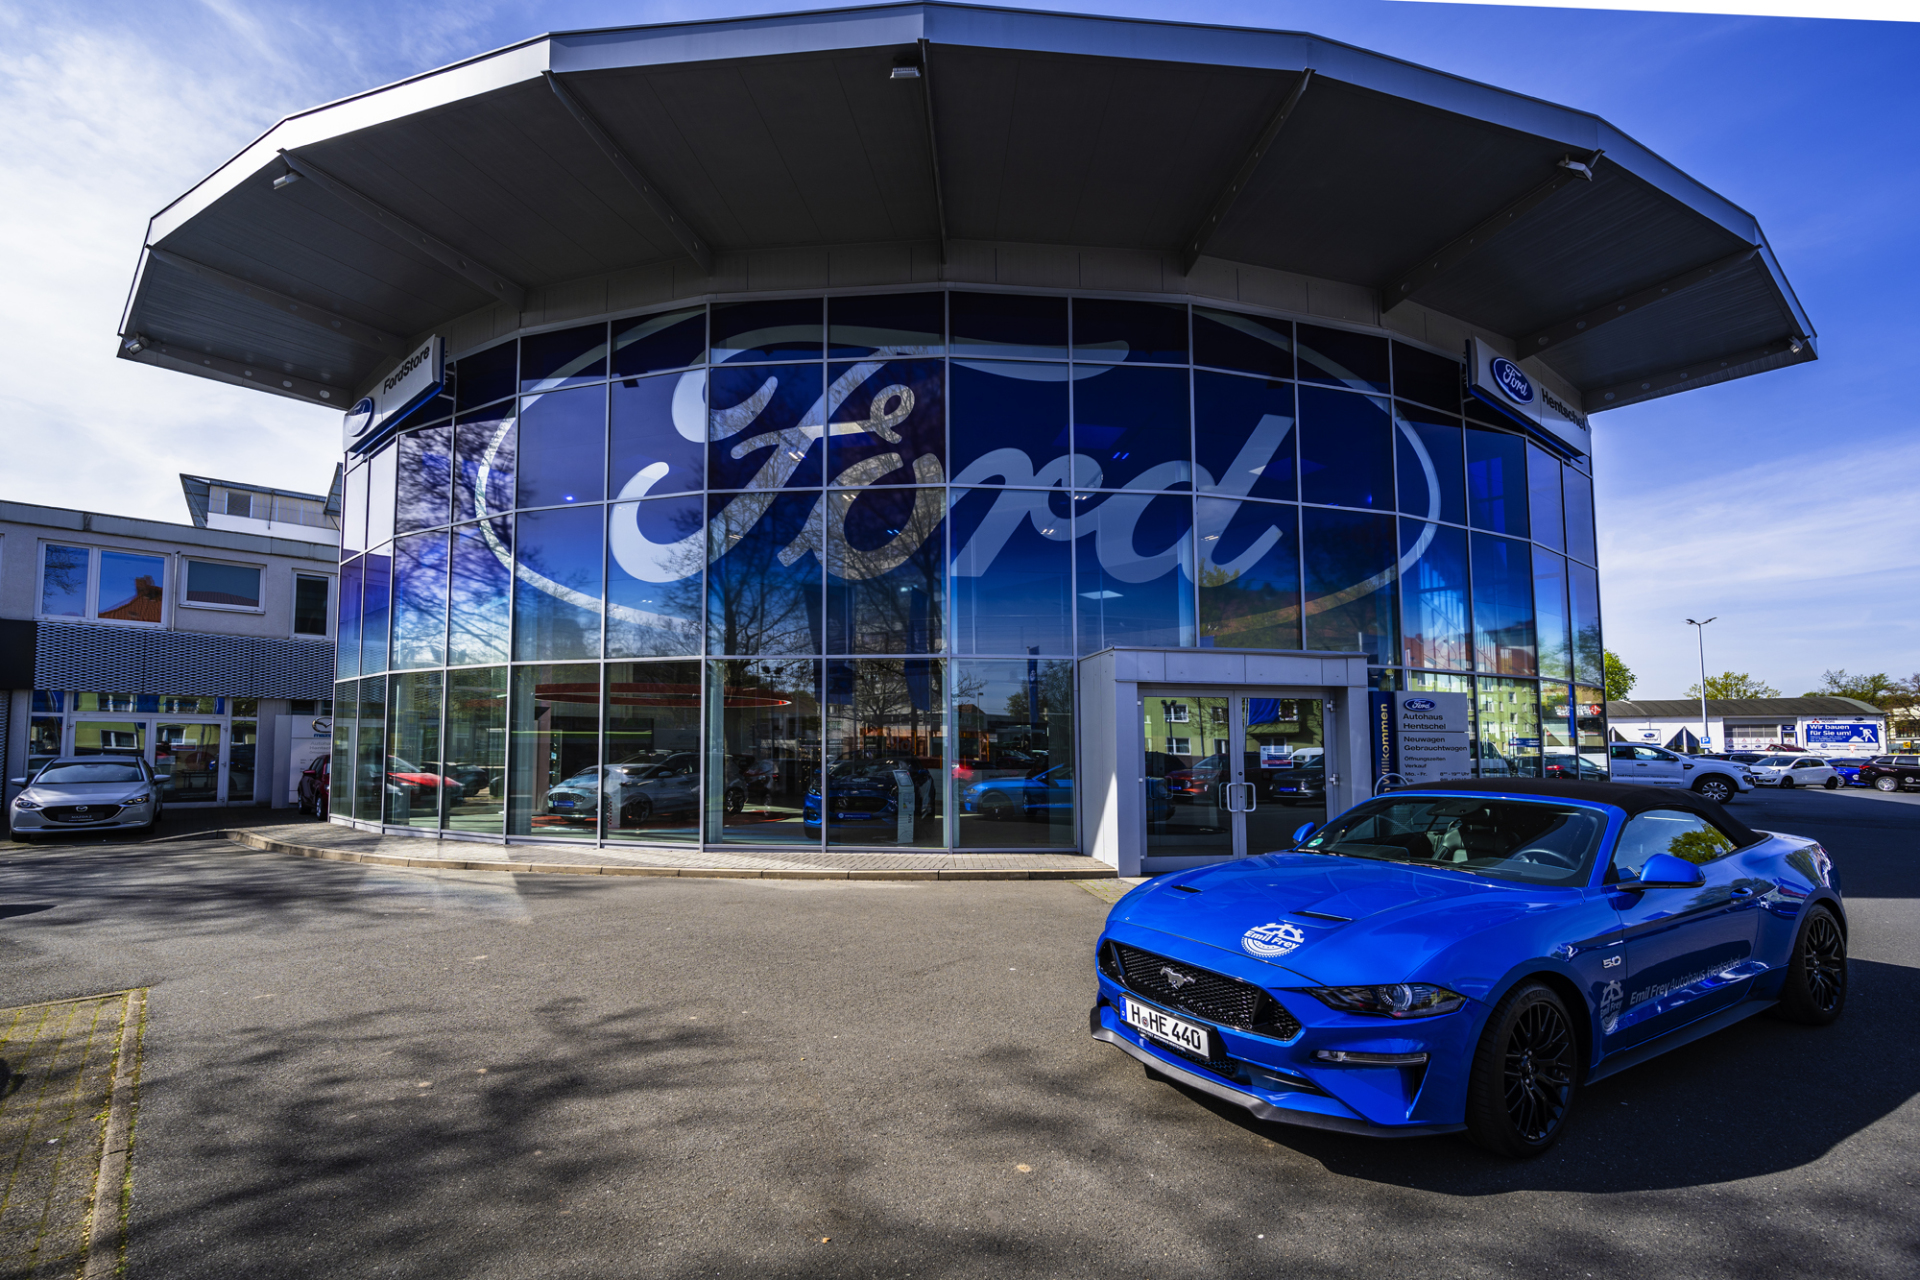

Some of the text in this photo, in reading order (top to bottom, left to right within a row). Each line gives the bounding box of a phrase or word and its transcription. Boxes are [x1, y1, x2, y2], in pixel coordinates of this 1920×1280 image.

[383, 346, 430, 395] FordStore
[1502, 363, 1528, 397] Ford
[1541, 388, 1586, 431] Hentschel
[610, 325, 1295, 587] Ford
[1404, 744, 1467, 753] Gebrauchtwagen
[1243, 930, 1300, 950] Emil Frey
[1629, 954, 1742, 1005] Emil Frey Autohaus Hentschel
[1131, 1004, 1141, 1026] H
[1149, 1012, 1169, 1038] HE
[1171, 1024, 1201, 1050] 440
[1600, 1000, 1623, 1018] Emil Frey
